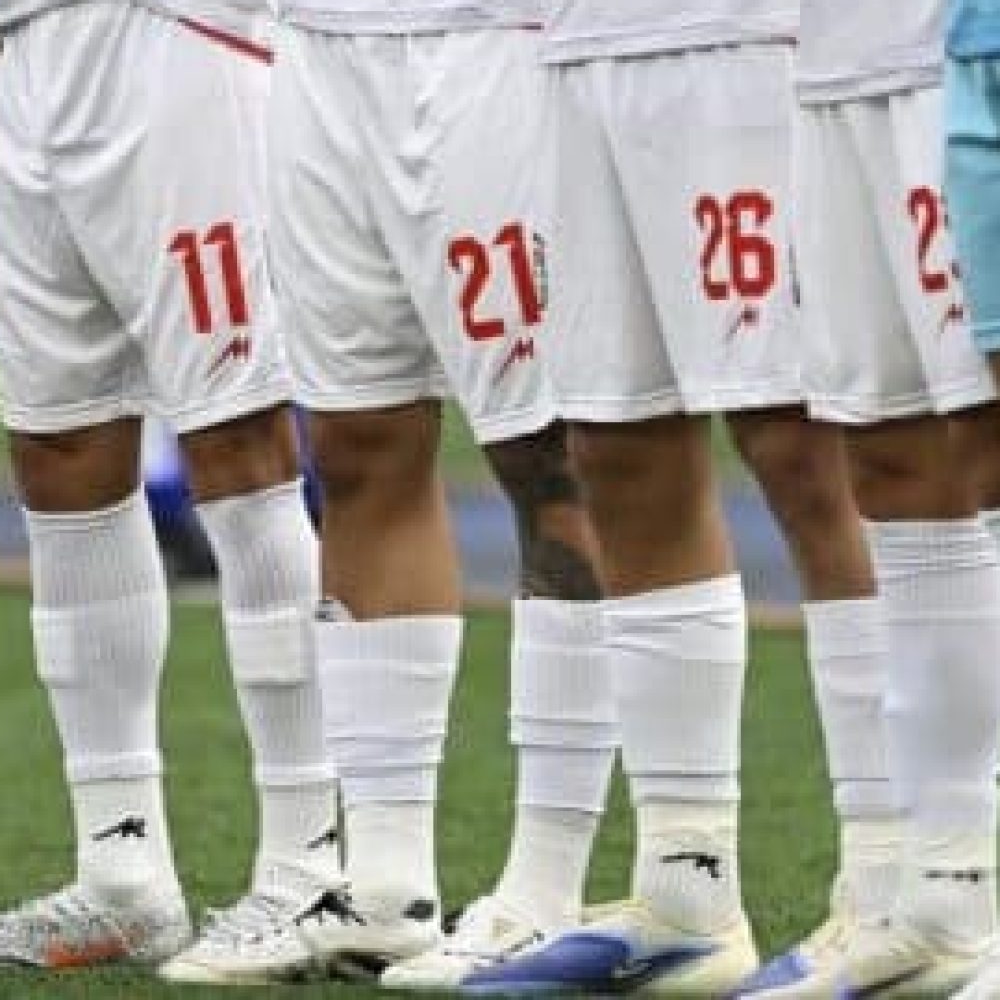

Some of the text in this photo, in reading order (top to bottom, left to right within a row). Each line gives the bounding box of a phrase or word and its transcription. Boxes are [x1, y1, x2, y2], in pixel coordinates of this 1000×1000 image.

[167, 222, 249, 334] 11
[447, 221, 542, 341] 21
[695, 190, 776, 300] 26
